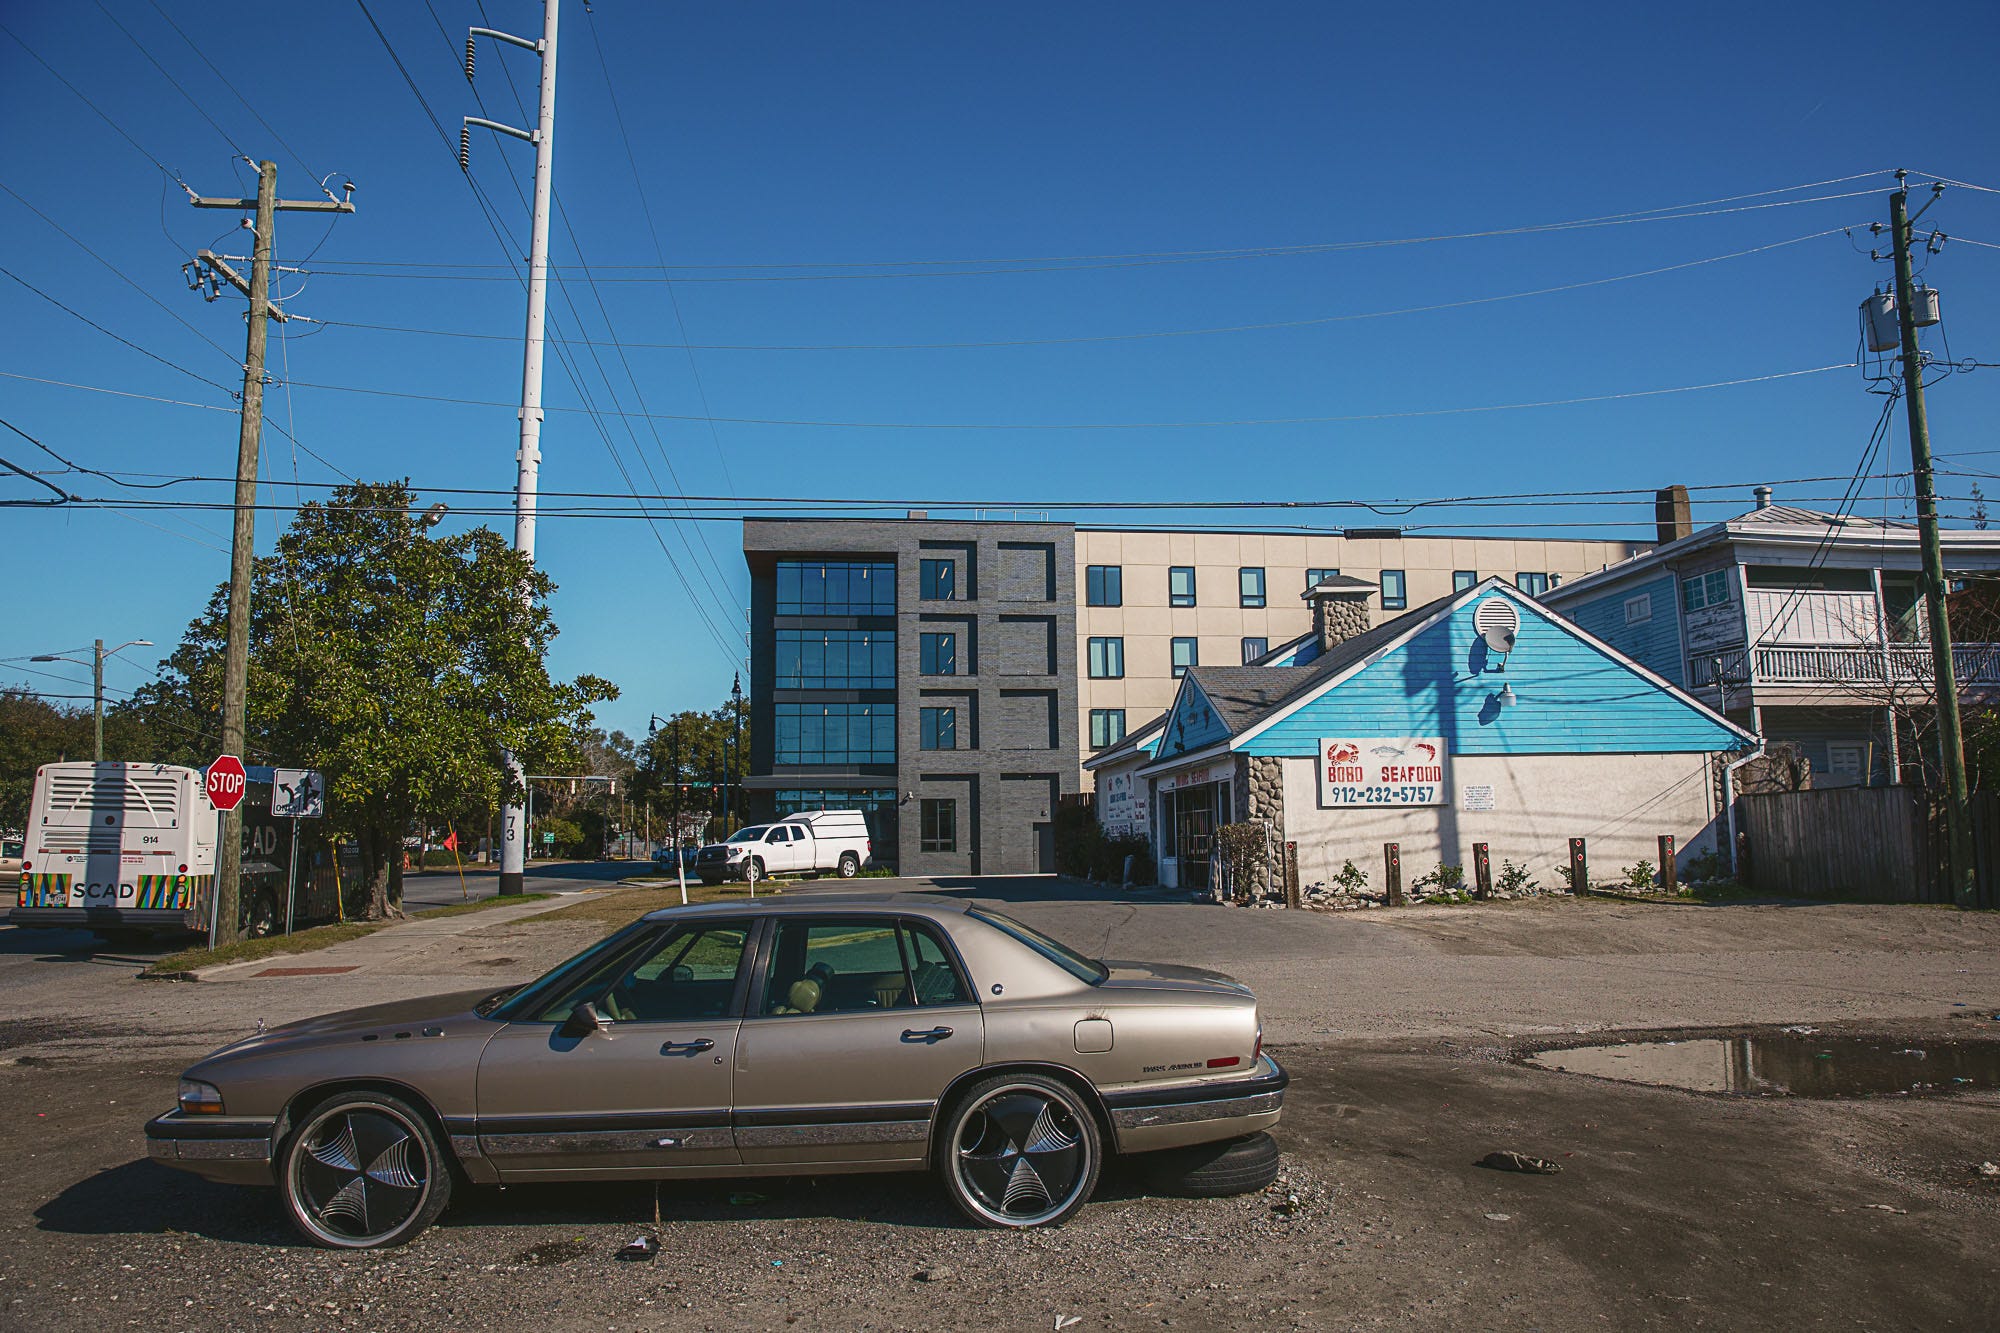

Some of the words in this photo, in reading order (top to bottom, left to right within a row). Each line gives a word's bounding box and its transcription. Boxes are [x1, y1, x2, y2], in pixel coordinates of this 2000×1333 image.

[1328, 766, 1363, 782] BOBO
[1381, 766, 1442, 782] SEAFOOD
[209, 771, 243, 794] STOP
[1332, 786, 1434, 803] 912-232-5757
[142, 836, 158, 844] 914
[242, 825, 277, 855] CAD
[72, 883, 135, 899] SCAD
